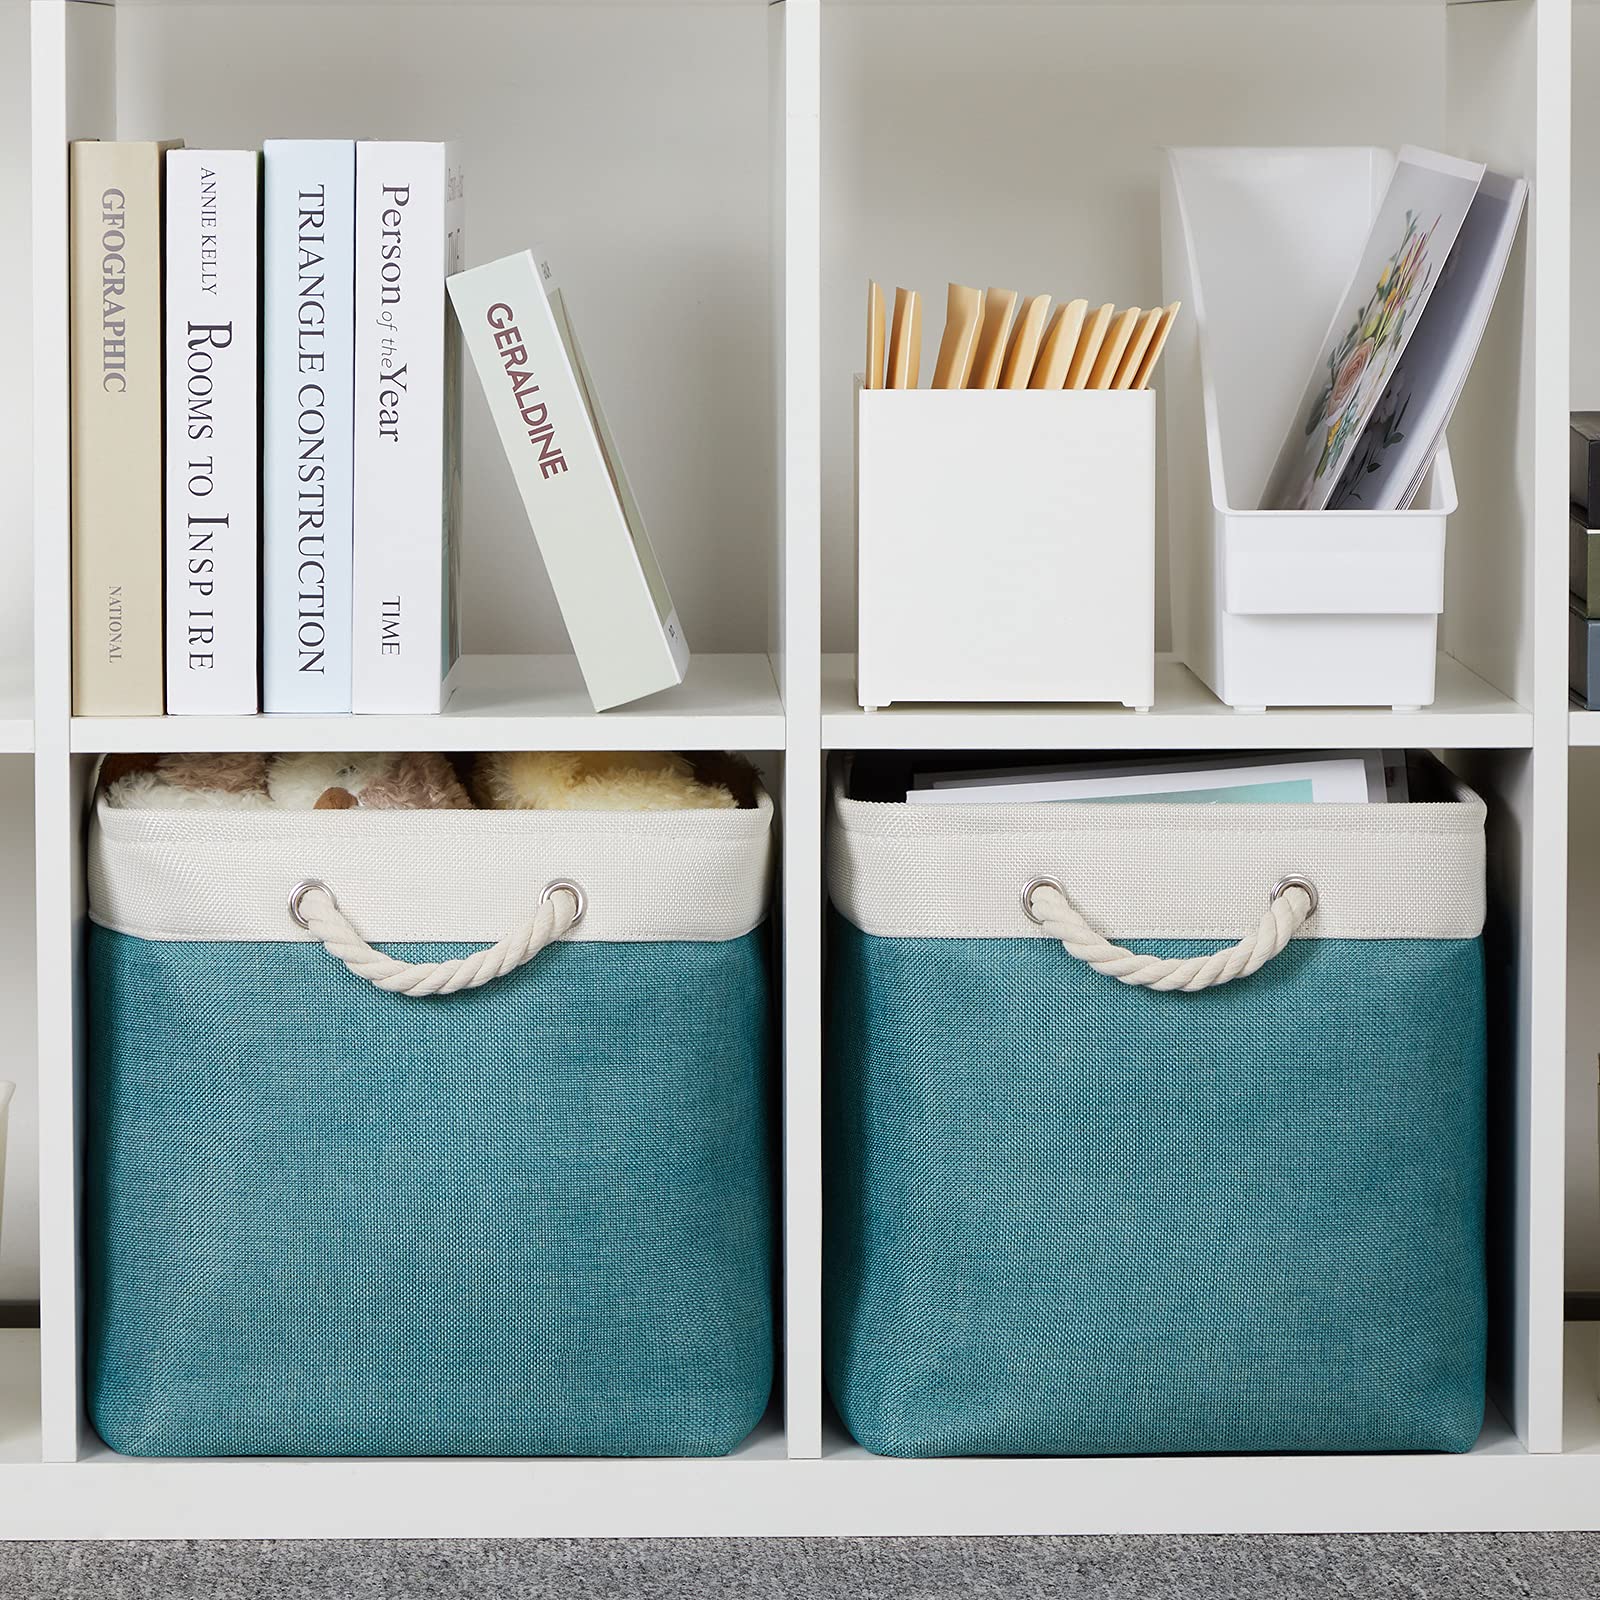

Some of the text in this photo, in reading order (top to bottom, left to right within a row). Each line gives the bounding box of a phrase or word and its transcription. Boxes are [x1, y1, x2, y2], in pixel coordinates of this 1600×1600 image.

[101, 187, 127, 394] GFOGRAPHIC
[201, 166, 217, 296] ANNIE KELLY
[380, 183, 410, 306] Person
[375, 310, 398, 332] of
[297, 183, 326, 676] TRIANGLE CONSTRUCTION
[487, 303, 569, 479] GERALDINE
[108, 585, 123, 664] NATIONAL
[381, 595, 401, 656] TIME
